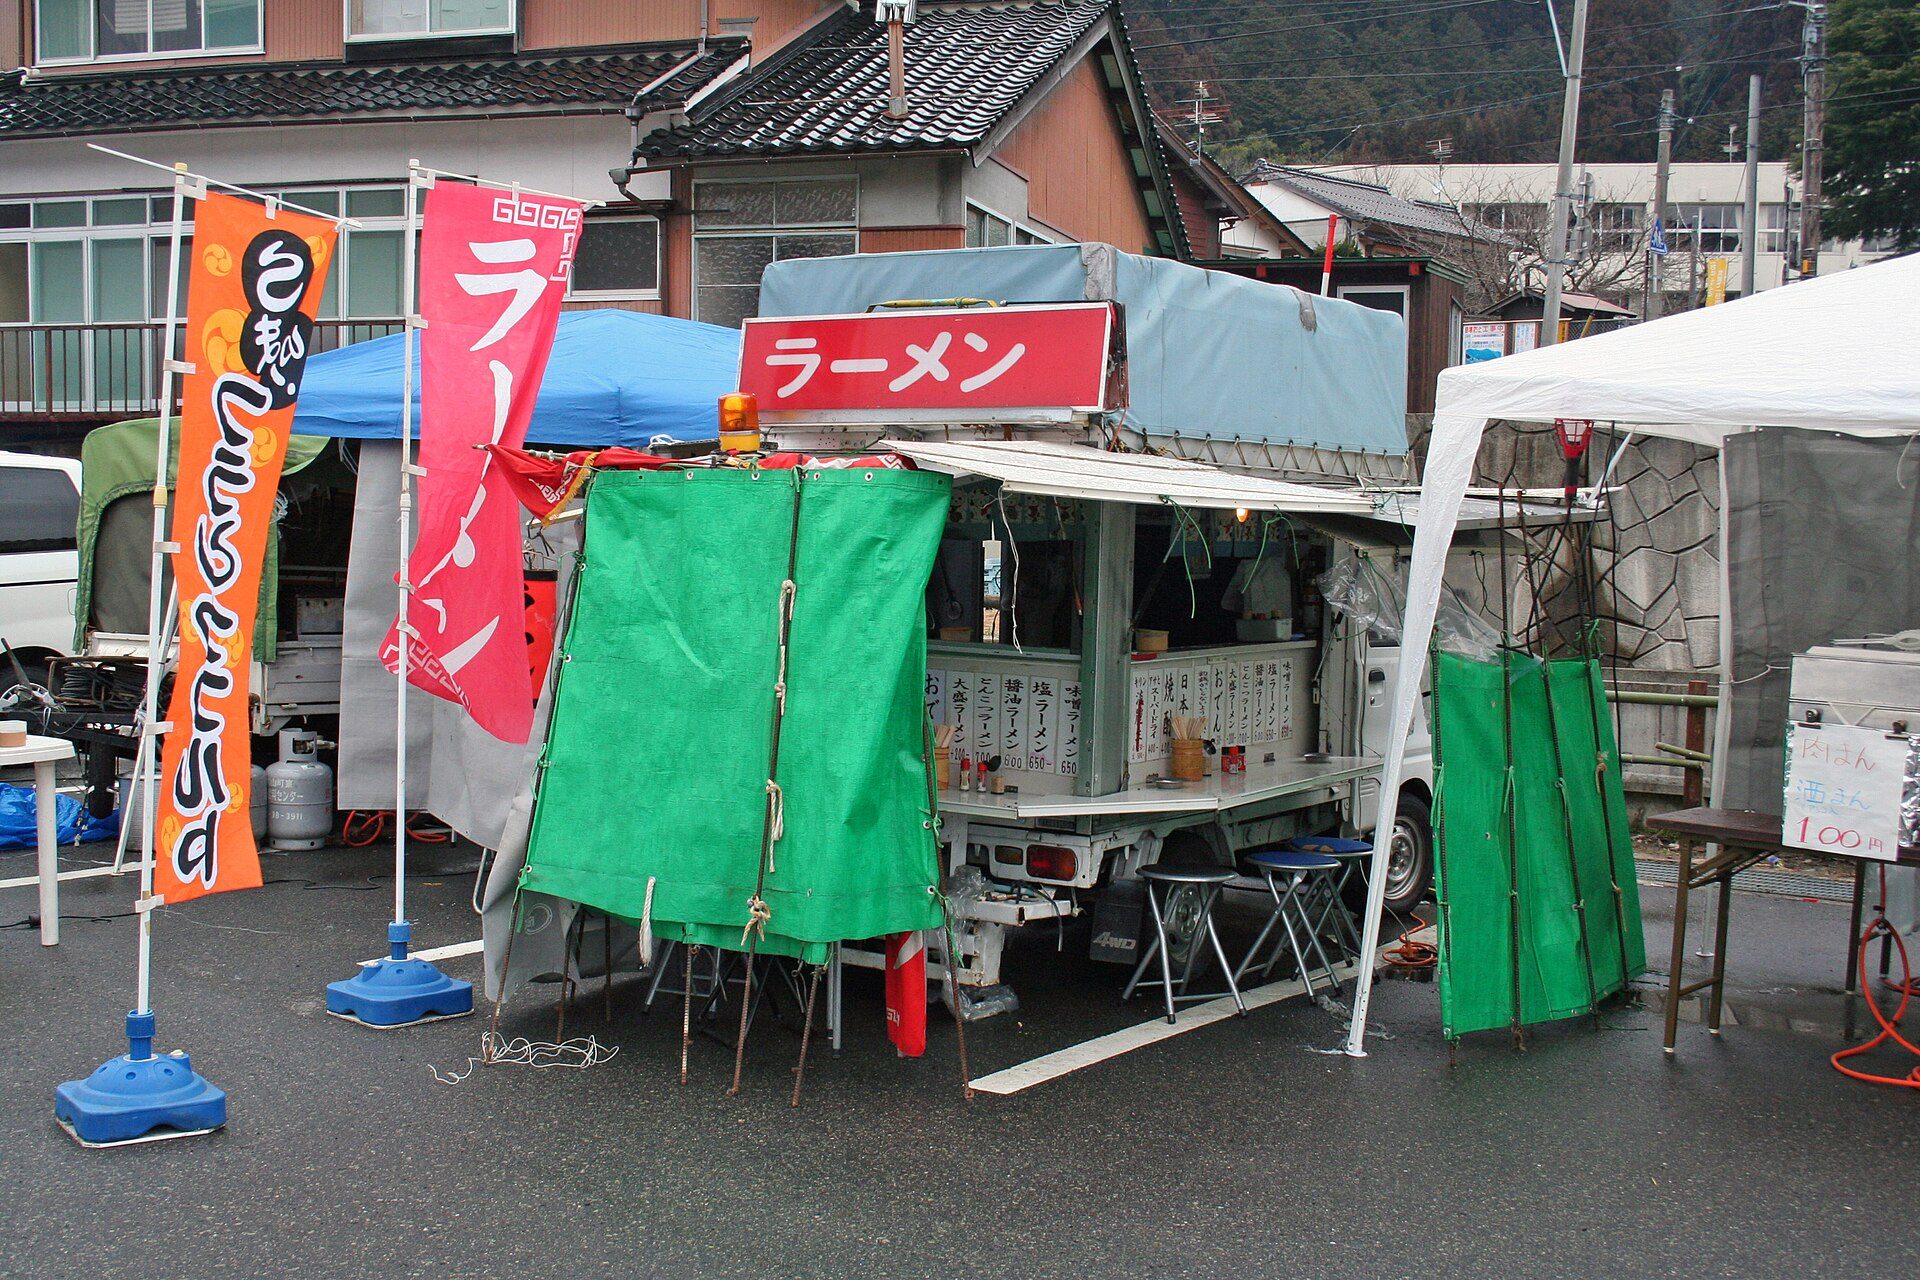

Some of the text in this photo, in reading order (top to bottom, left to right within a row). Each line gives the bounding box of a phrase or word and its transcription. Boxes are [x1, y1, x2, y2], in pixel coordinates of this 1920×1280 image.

[764, 331, 1026, 399] ラーメン
[418, 238, 548, 676] ラーメン
[925, 673, 940, 720] おで
[952, 678, 970, 744] 大盛ラーメン
[977, 677, 994, 748] とんこつラーメン
[1004, 678, 1024, 769] 醤油ラーメン 600
[1032, 681, 1053, 753] 塩ラーメン
[1163, 672, 1174, 737] 焼酎
[1178, 674, 1189, 715] 日本
[1213, 668, 1223, 732] おでん
[1228, 668, 1237, 729] 大盛ラーメン
[1240, 665, 1250, 730] とんこつラーメン
[1255, 663, 1265, 727] 醤油ラーメン
[1267, 663, 1278, 726] 塩ラーメン
[1282, 660, 1292, 723] 味噌ラーメン
[1061, 685, 1082, 774] 味噌ラーメン 650
[1802, 736, 1876, 771] 肉まん
[1796, 816, 1883, 853] 100円
[1092, 931, 1137, 950] 4WD
